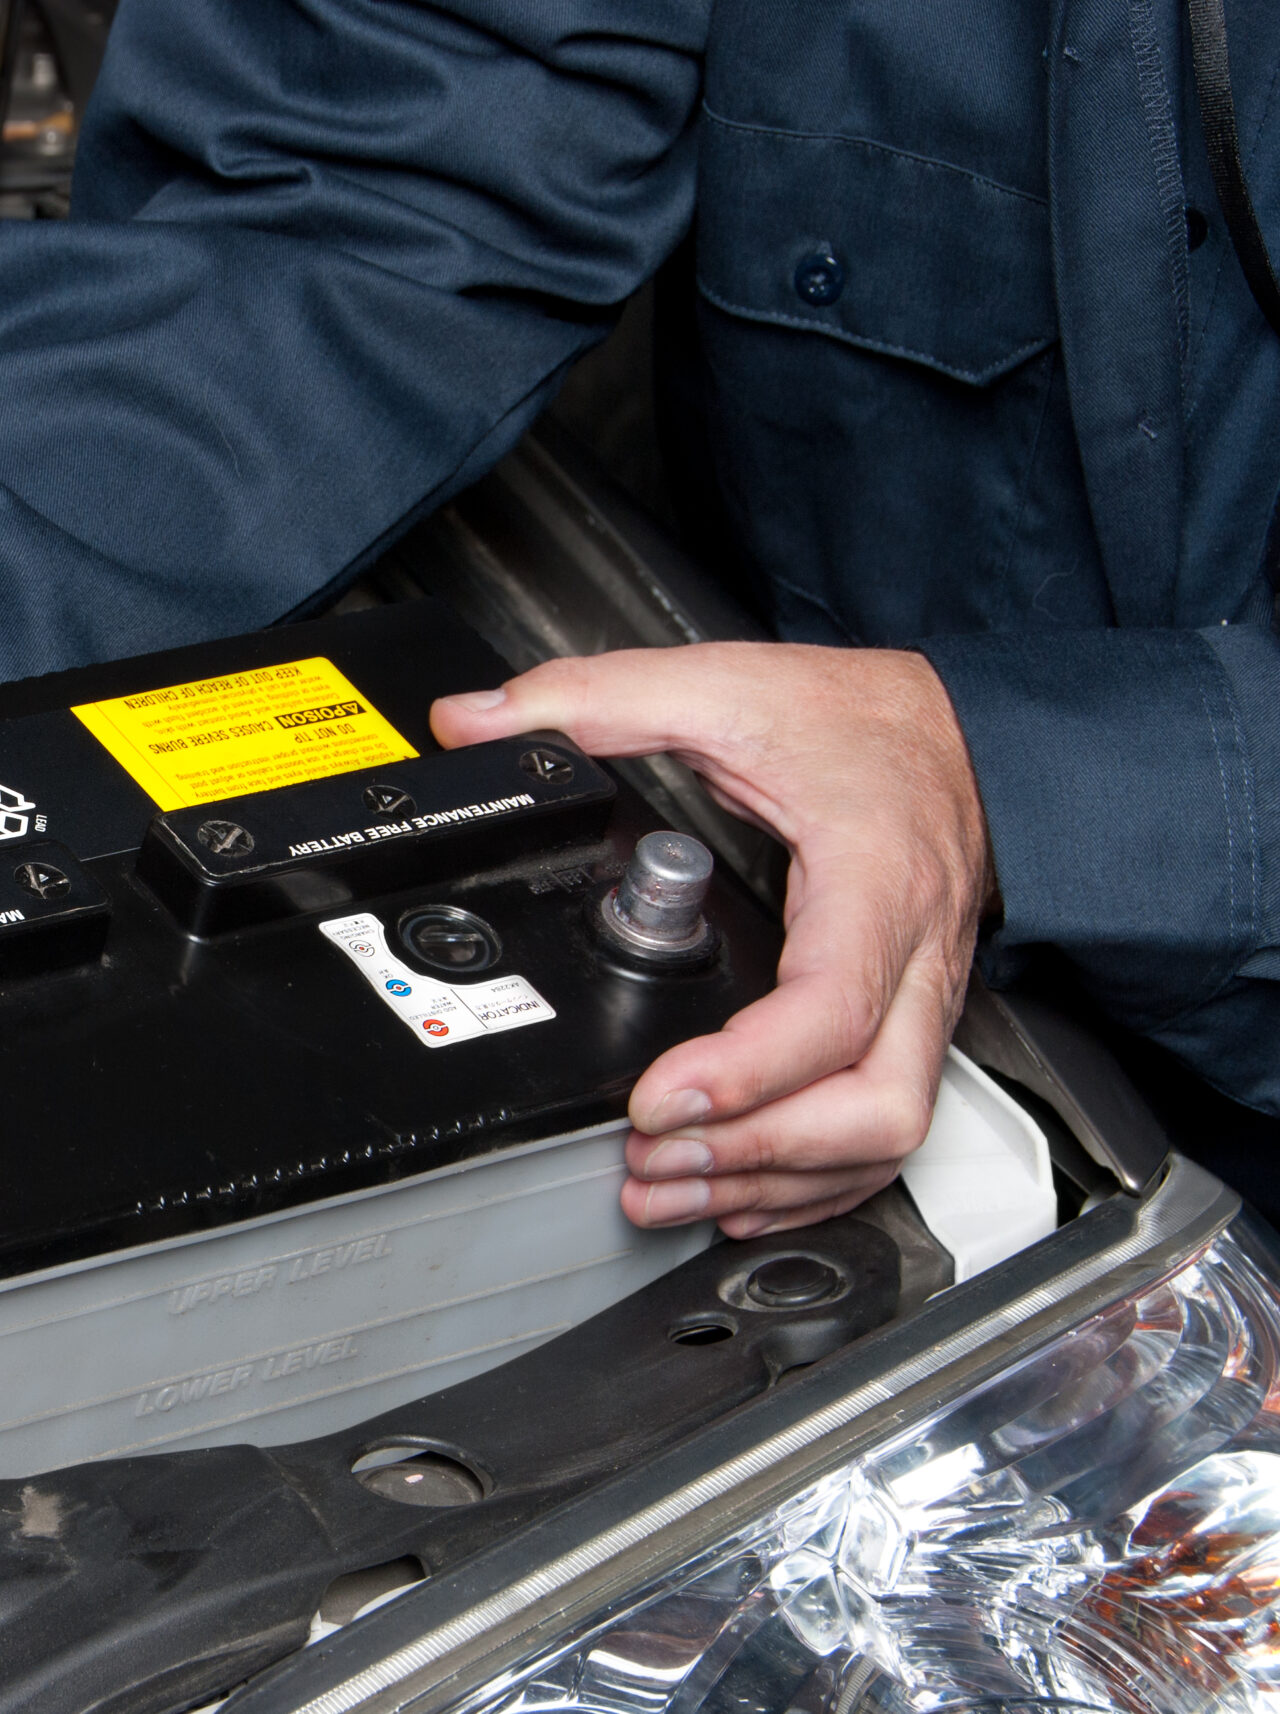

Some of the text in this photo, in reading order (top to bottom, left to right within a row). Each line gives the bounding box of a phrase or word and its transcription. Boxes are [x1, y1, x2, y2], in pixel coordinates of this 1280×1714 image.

[123, 666, 301, 709] KEEP OUT OF REACH OF CHILDREN
[303, 692, 340, 703] Contains
[185, 706, 218, 718] accident
[227, 709, 251, 720] Avoid
[141, 718, 162, 728] with
[175, 721, 195, 731] with
[196, 715, 227, 726] contact
[148, 705, 346, 754] POISON CAUSES SEVERE BURNS
[294, 722, 356, 743] DO NOT TIP
[330, 733, 378, 747] connections
[272, 748, 298, 760] proper
[298, 743, 331, 754] without
[331, 747, 359, 757] charge
[226, 756, 270, 770] instruction
[274, 759, 306, 770] booster
[209, 765, 226, 774] and
[245, 766, 273, 776] cables
[282, 769, 303, 779] eyes
[303, 764, 329, 776] shield
[189, 779, 208, 789] post
[208, 774, 235, 785] adjust
[247, 778, 267, 787] face
[266, 774, 282, 784] and
[225, 783, 248, 791] from
[34, 814, 48, 833] LEAD
[287, 792, 536, 857] MAINTENANCE FREE BATTERY
[478, 1000, 540, 1020] INDICATOR
[168, 1234, 392, 1315] UPPER LEVEL
[135, 1336, 358, 1417] LOWER LEVEL
